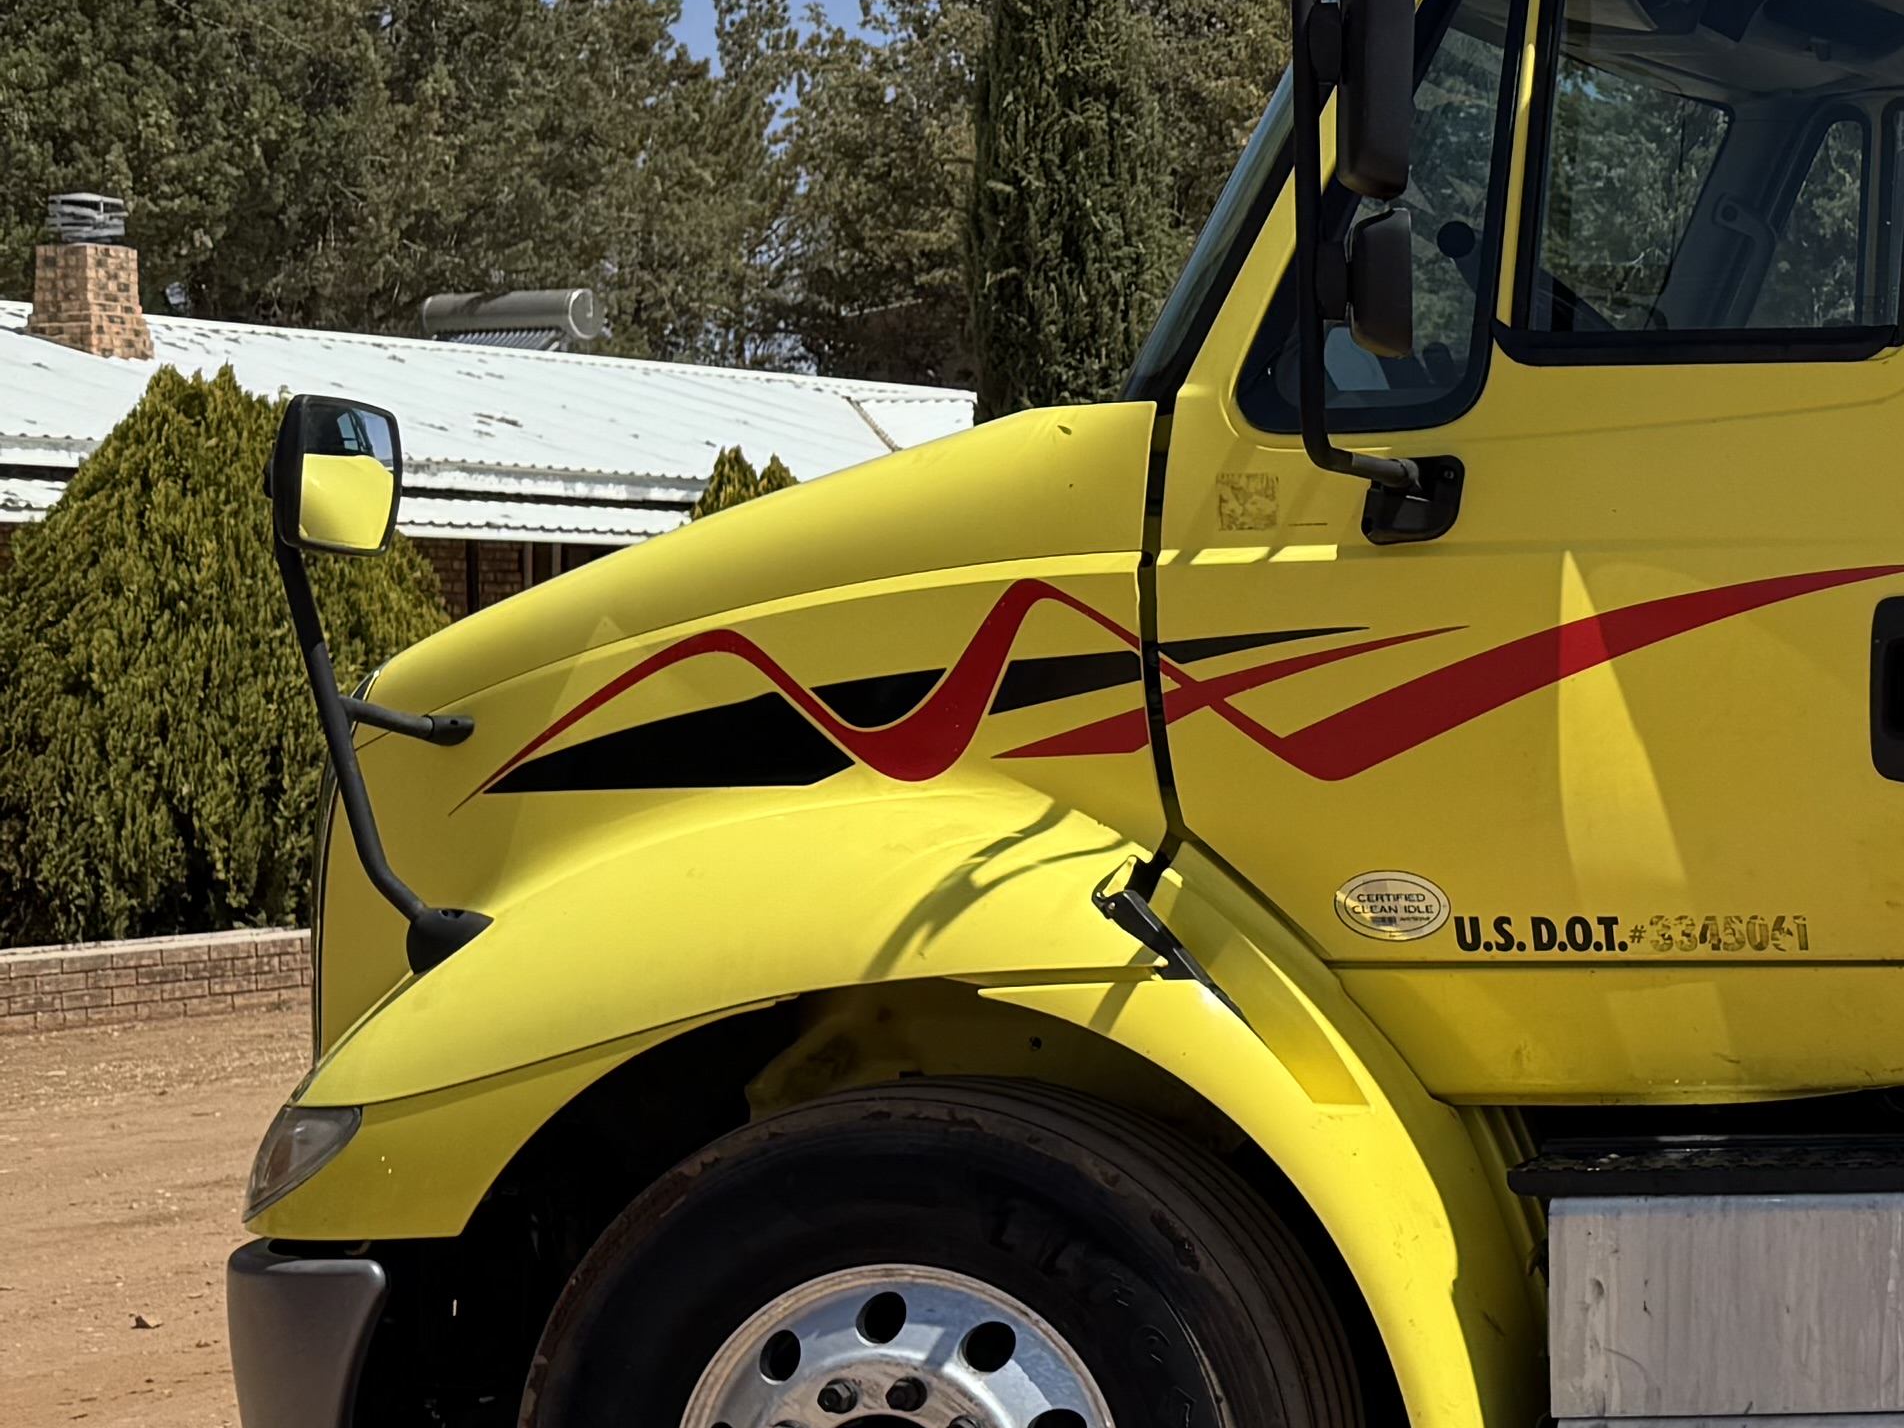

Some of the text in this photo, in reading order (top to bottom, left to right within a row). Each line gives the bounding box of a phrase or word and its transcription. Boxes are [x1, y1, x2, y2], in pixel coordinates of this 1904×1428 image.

[1356, 893, 1426, 903] CERTIFIED
[1352, 904, 1434, 914] CLEAN IDLE
[1455, 916, 1526, 952] U.S.
[1533, 916, 1628, 952] D.O.T.
